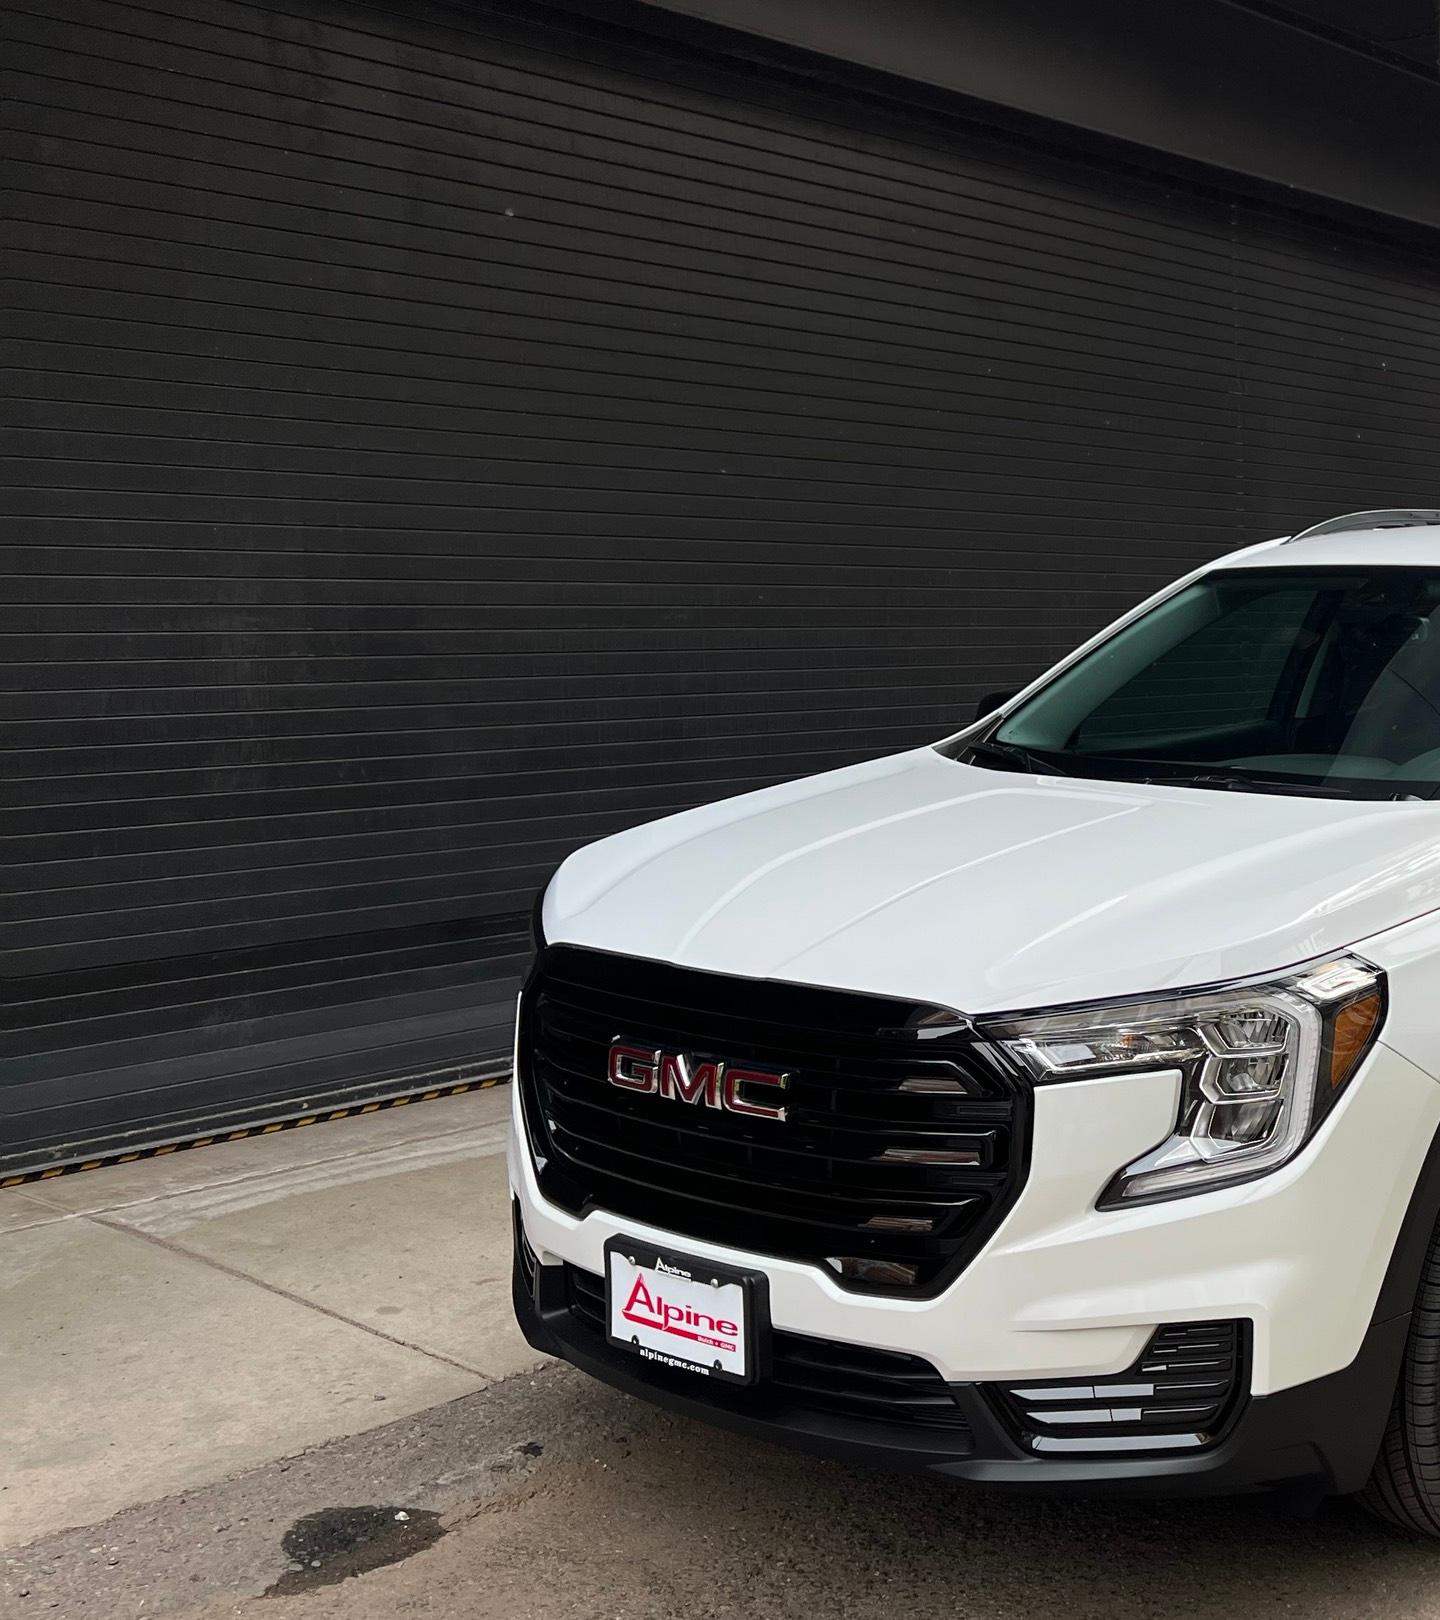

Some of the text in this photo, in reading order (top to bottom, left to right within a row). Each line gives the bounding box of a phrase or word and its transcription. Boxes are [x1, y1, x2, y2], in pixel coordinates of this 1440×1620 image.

[607, 1044, 789, 1122] GMC
[654, 1257, 692, 1279] Alpine
[623, 1272, 738, 1337] Alpine
[720, 1341, 736, 1351] GMC
[639, 1348, 710, 1376] alpinegmc.com
